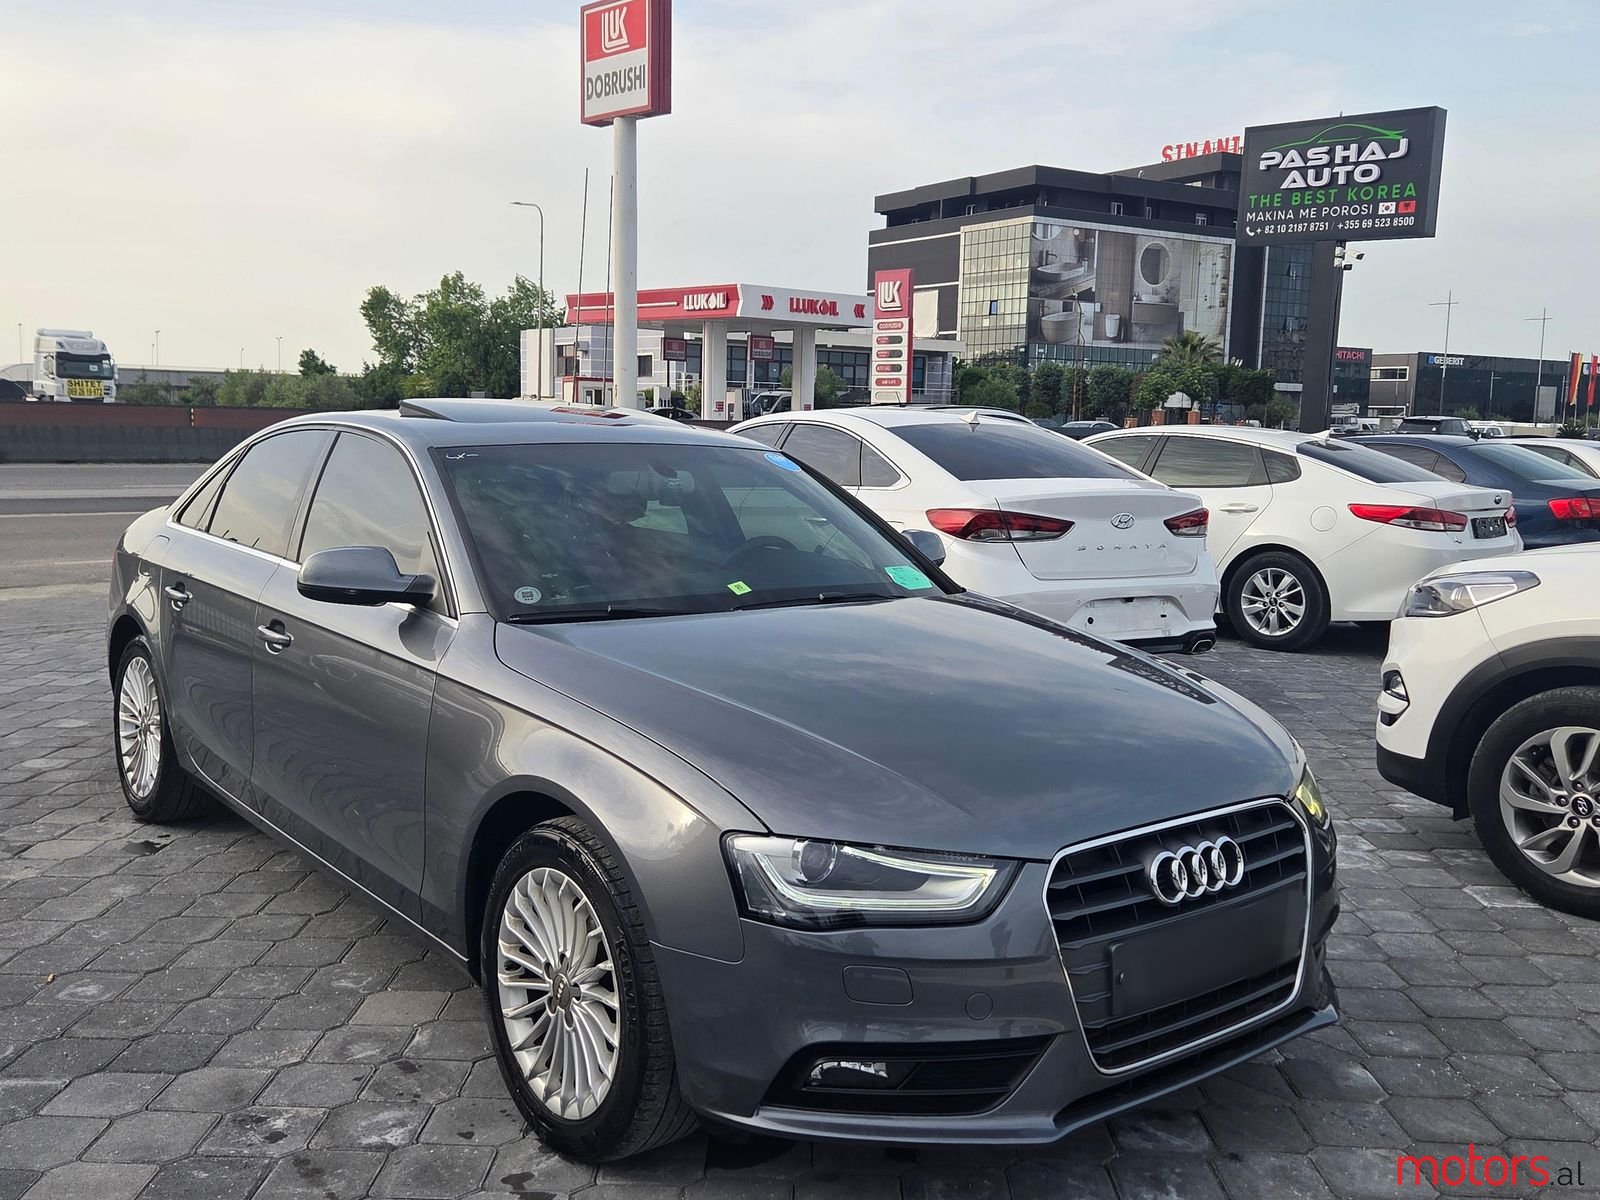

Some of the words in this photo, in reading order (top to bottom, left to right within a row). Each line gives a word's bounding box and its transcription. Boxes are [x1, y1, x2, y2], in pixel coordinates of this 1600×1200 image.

[586, 64, 646, 101] DOBRUSHI
[1161, 135, 1241, 161] SINANI
[1259, 138, 1409, 171] PASHAJ
[1280, 164, 1381, 189] AUTO
[1249, 193, 1282, 209] THE
[1291, 188, 1338, 206] BEST
[1347, 182, 1416, 202] KOREA
[1246, 209, 1294, 222] MAKINA
[1299, 207, 1317, 219] ME
[1322, 204, 1373, 218] POROSI
[1264, 224, 1275, 234] 82
[1277, 223, 1287, 233] 10
[1287, 222, 1309, 233] 2187
[1309, 221, 1329, 231] 8751
[1337, 219, 1360, 230] +355
[1362, 218, 1372, 228] 69
[1374, 217, 1391, 228] 523
[1393, 216, 1415, 227] 8500
[1433, 356, 1465, 366] GEBERIT
[67, 379, 102, 388] SHITET
[1077, 543, 1167, 552] SONATA
